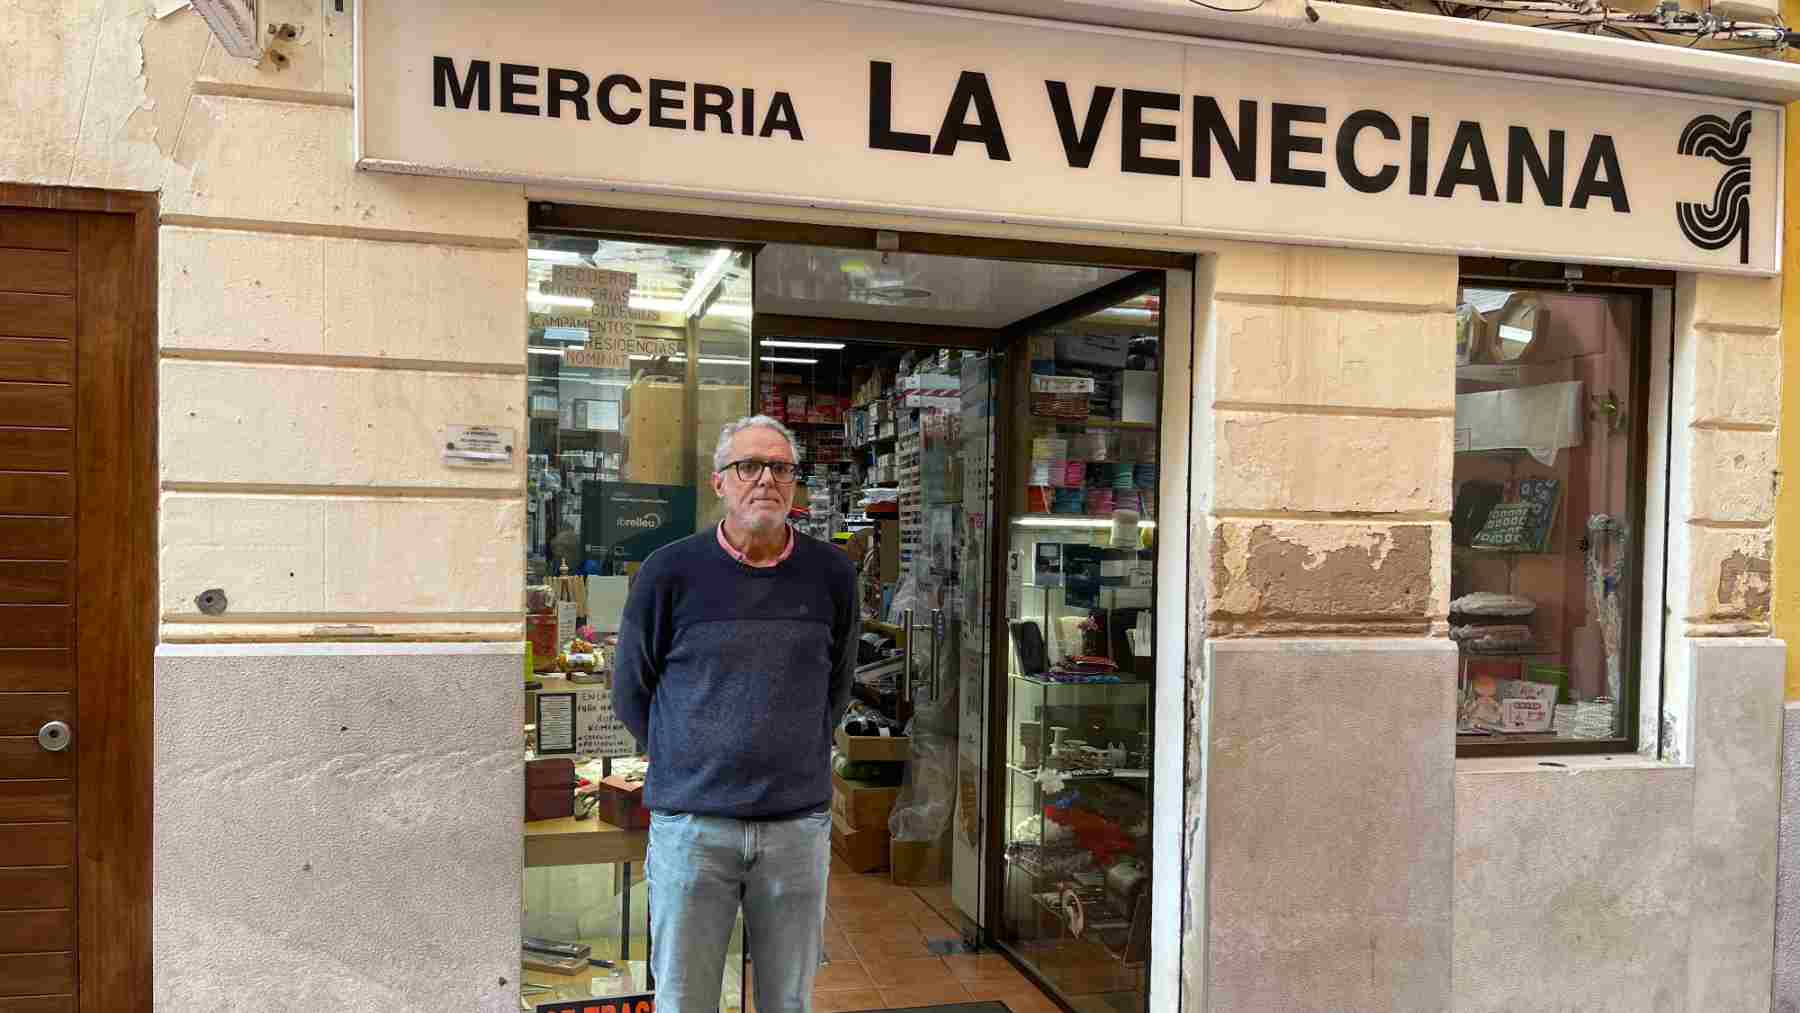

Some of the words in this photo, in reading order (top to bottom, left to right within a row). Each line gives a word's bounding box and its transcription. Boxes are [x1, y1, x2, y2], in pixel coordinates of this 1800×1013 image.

[432, 55, 804, 141] MERCERIA
[868, 60, 1012, 162] LA
[1044, 79, 1631, 214] VENECIANA
